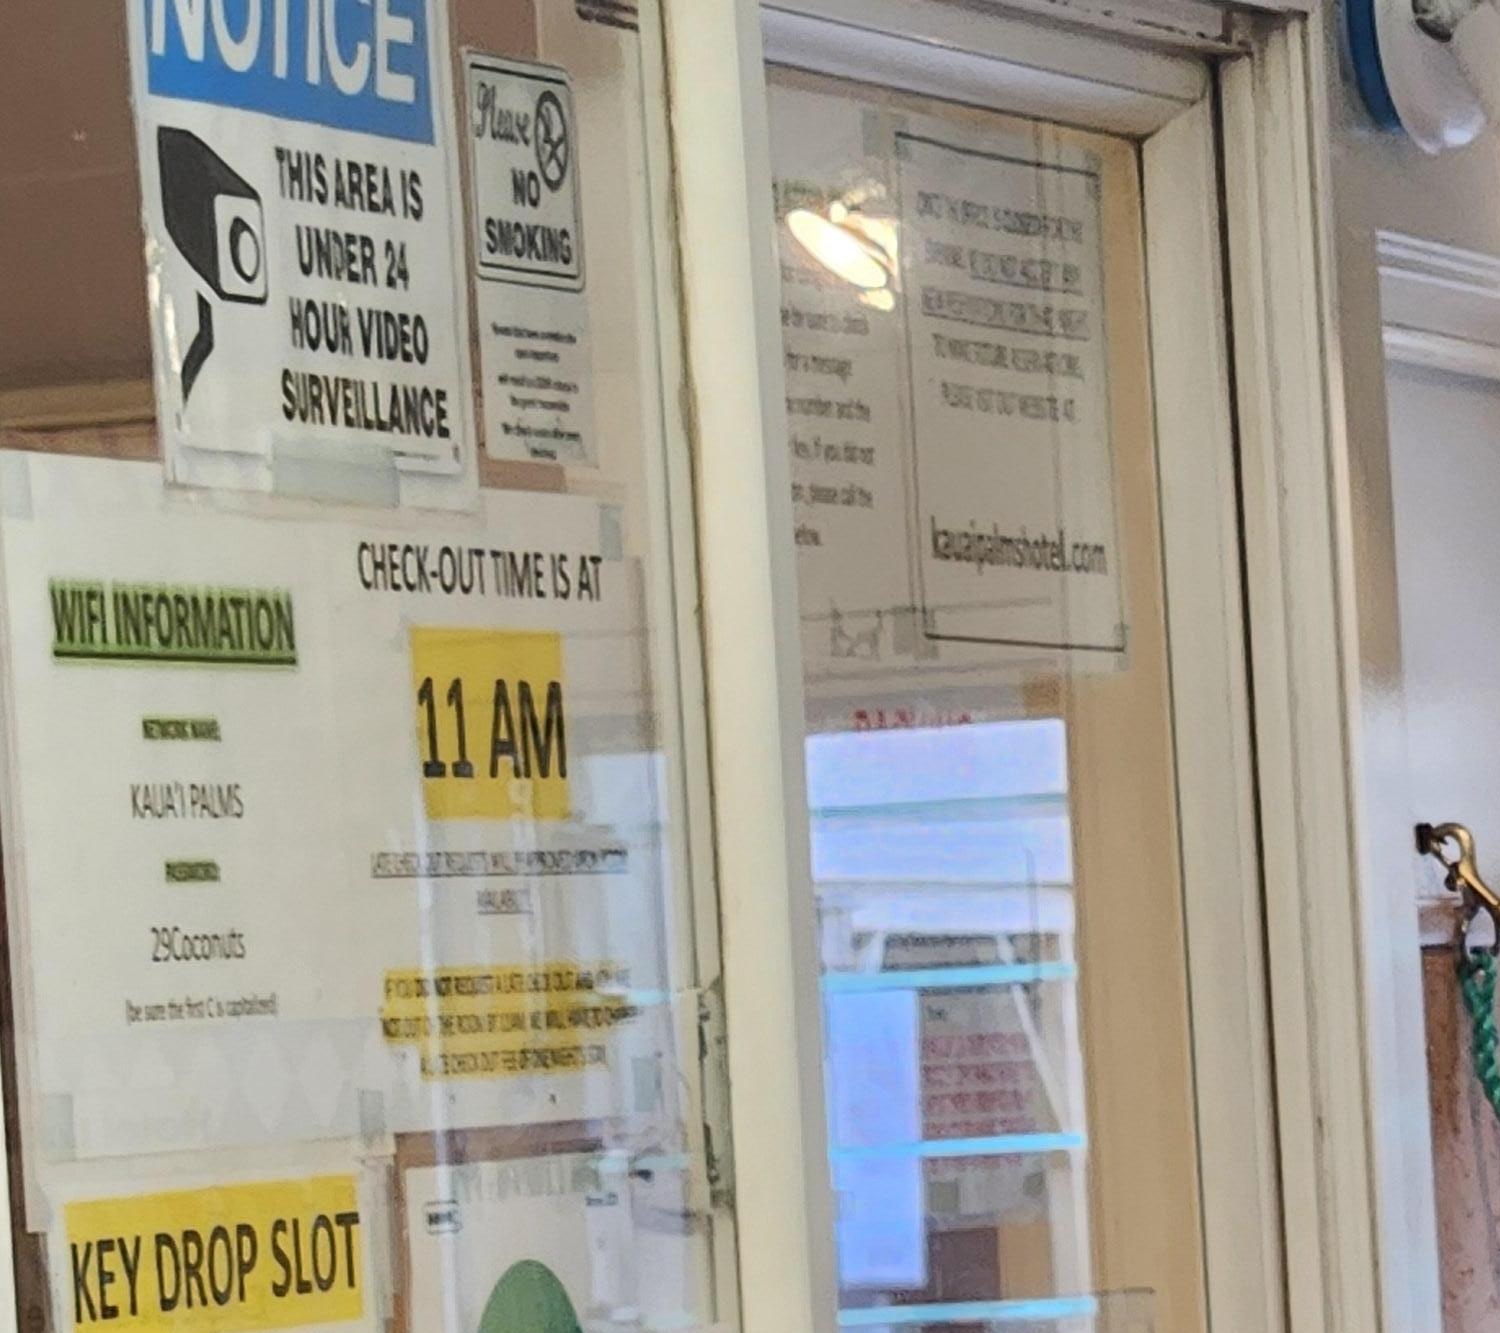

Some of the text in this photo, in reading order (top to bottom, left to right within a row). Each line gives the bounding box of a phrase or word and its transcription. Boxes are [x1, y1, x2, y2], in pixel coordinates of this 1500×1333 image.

[275, 146, 423, 221] THIS AREA IS
[511, 167, 541, 208] NO
[295, 224, 410, 292] UNDER 24
[485, 216, 573, 265] SMOKING
[289, 296, 429, 365] HOUR VIDEO
[281, 367, 450, 438] SURVEILLANCE
[358, 541, 602, 602] CHECK-OUT TIME IS AT
[931, 515, 1108, 576] kauaipalmshotel.com
[51, 586, 296, 651] WIFI INFORMATION
[418, 676, 567, 779] 11 AM
[151, 926, 247, 962] 29Coconuts
[70, 1211, 360, 1324] KEY DROP SLOT
